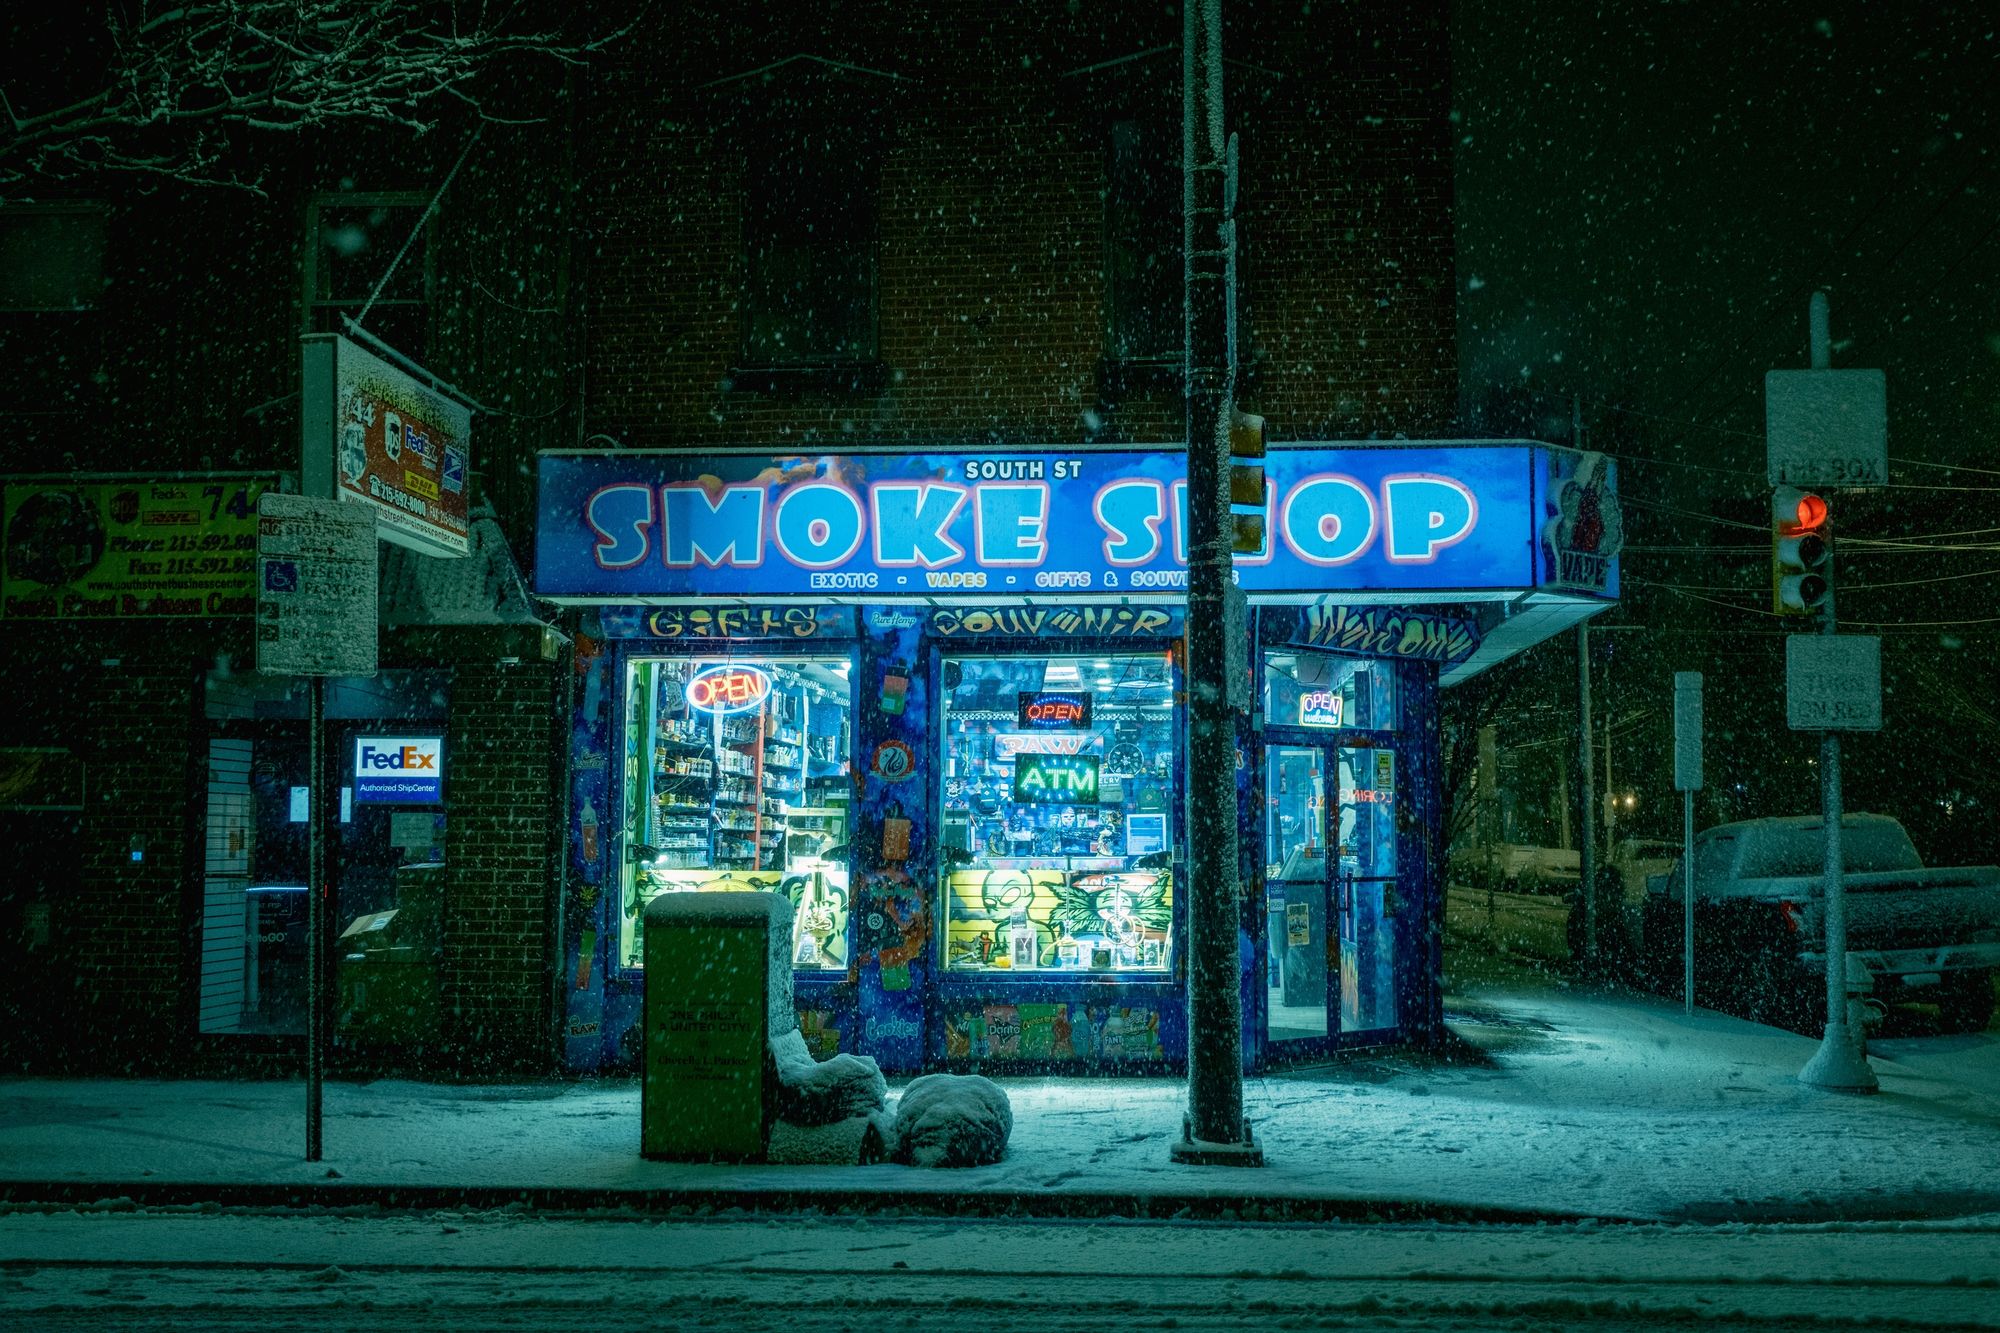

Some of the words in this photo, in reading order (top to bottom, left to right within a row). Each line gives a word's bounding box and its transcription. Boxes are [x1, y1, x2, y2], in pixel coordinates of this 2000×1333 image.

[965, 460, 1045, 479] SOUTH
[1053, 460, 1082, 478] ST
[587, 482, 1047, 568] SMOKE
[811, 572, 878, 588] EXOTIC
[926, 572, 987, 588] VAPES
[1035, 571, 1091, 587] GIFTS
[1104, 571, 1118, 586] &
[649, 607, 816, 638] GIFTS
[932, 606, 1172, 636] SOUVENIR
[1306, 604, 1475, 660] WELCOME
[693, 672, 765, 707] OPEN
[1027, 704, 1083, 721] OPEN
[1304, 692, 1340, 716] OPEN
[361, 745, 435, 769] FedEx
[1002, 735, 1086, 756] RAW
[360, 784, 397, 792] Authorized
[398, 783, 436, 793] ShipCenter
[1020, 766, 1096, 791] ATM
[570, 1023, 600, 1036] RAW
[866, 1016, 920, 1041] Cookies
